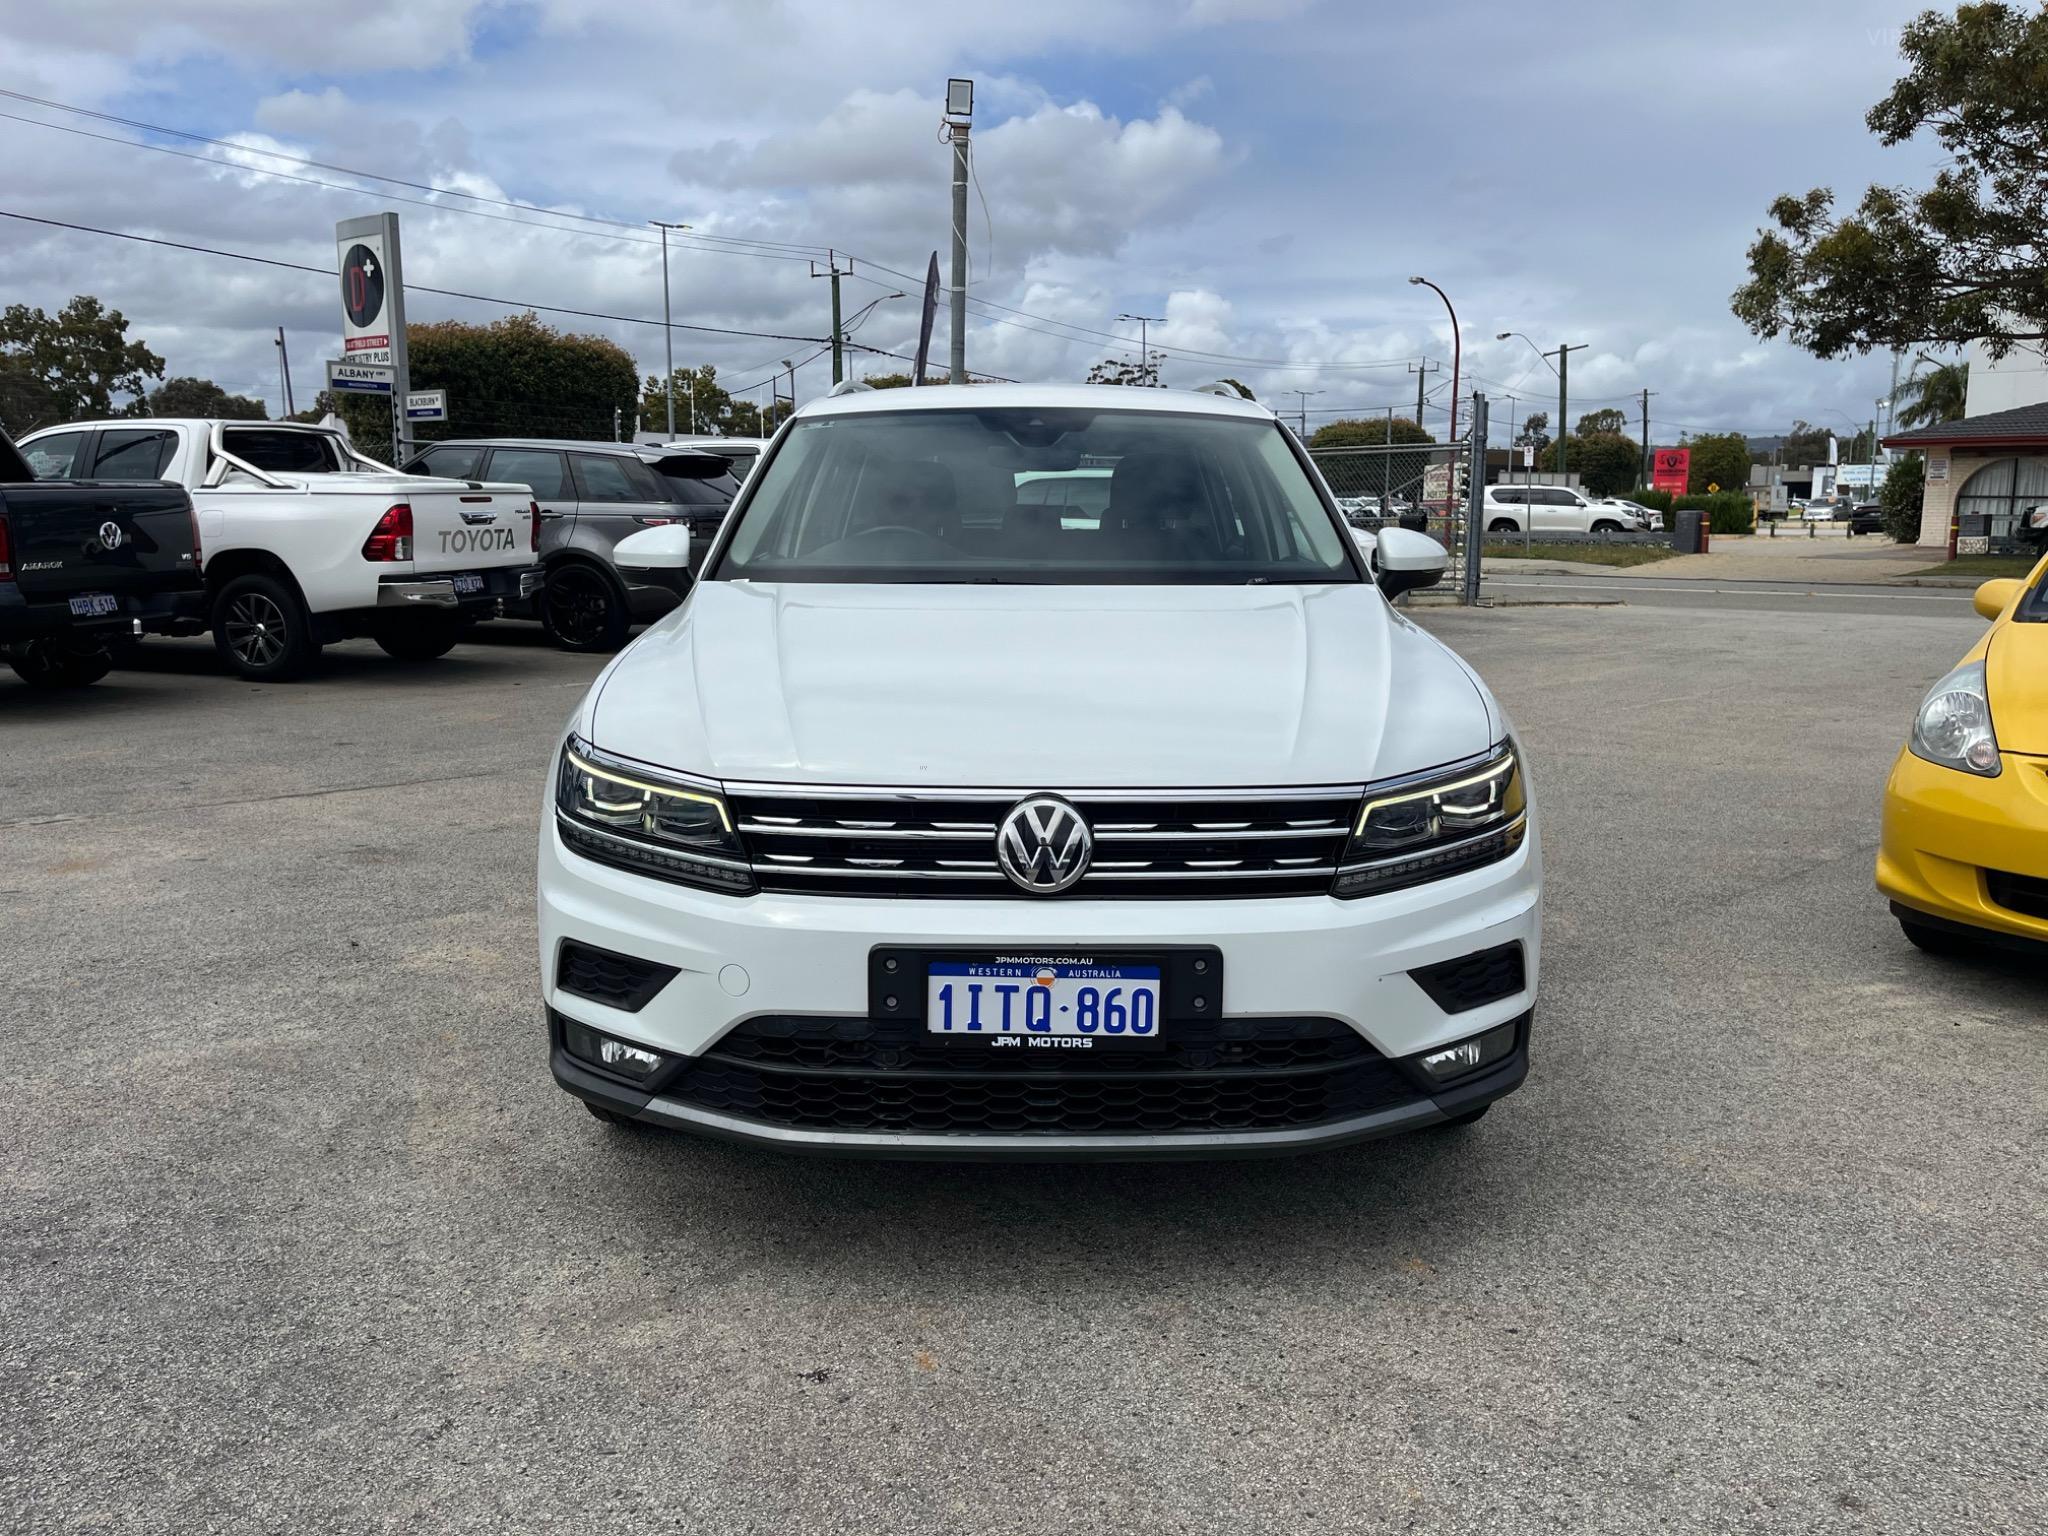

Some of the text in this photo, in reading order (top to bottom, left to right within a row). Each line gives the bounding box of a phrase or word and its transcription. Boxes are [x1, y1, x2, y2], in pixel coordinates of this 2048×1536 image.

[373, 351, 390, 362] PLUS
[337, 368, 374, 379] ALBANY
[438, 528, 515, 554] TOYOTA
[995, 956, 1093, 965] JPMMOTORS.COM.AU
[968, 967, 1121, 978] WESTERN AUSTRALIA
[991, 1036, 1093, 1048] JPM MOTORS
